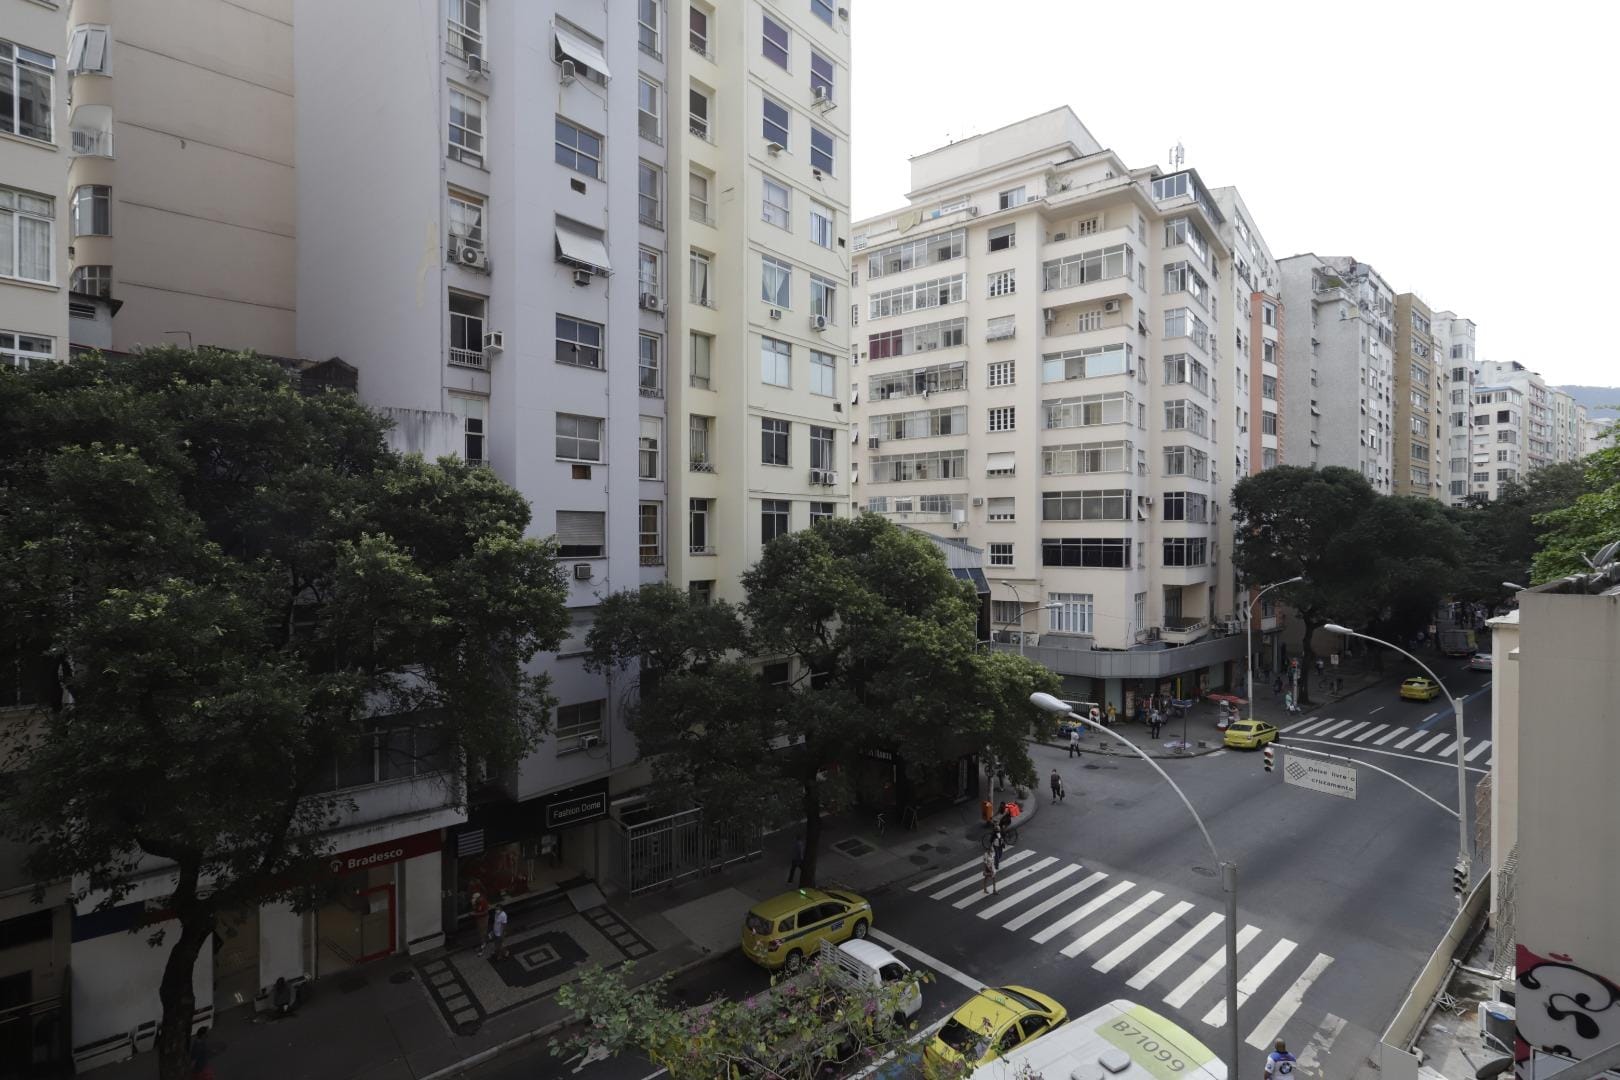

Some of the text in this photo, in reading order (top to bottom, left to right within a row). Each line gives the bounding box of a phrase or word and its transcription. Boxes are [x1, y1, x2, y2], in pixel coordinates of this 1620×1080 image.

[1308, 766, 1328, 775] Deixe
[1331, 771, 1347, 780] livre
[553, 807, 580, 819] Fashion
[347, 848, 404, 869] Bradesco
[1111, 1020, 1185, 1073] B71099
